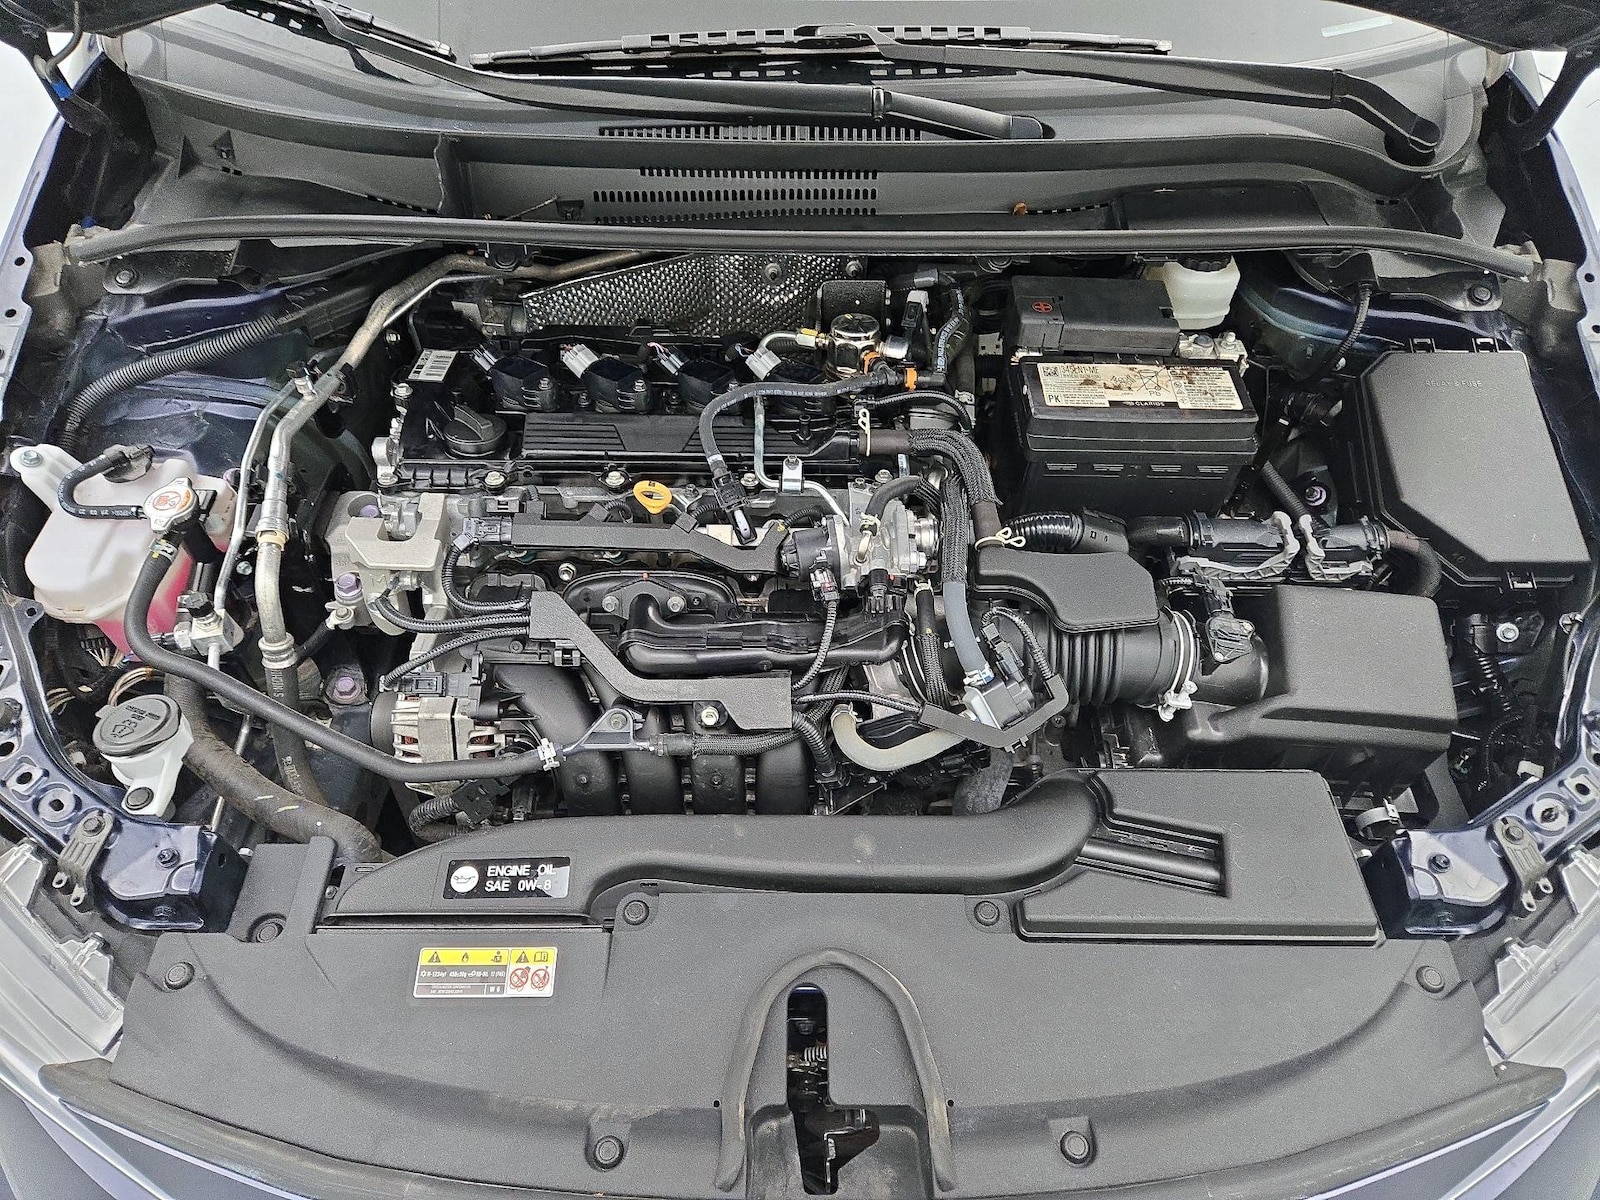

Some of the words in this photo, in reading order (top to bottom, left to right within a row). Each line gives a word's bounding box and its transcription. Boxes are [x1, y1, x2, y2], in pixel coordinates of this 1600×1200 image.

[1048, 394, 1061, 403] PK
[487, 864, 531, 877] ENGINE
[537, 863, 557, 876] OIL
[484, 880, 511, 892] SAE
[517, 879, 552, 892] 0W-8
